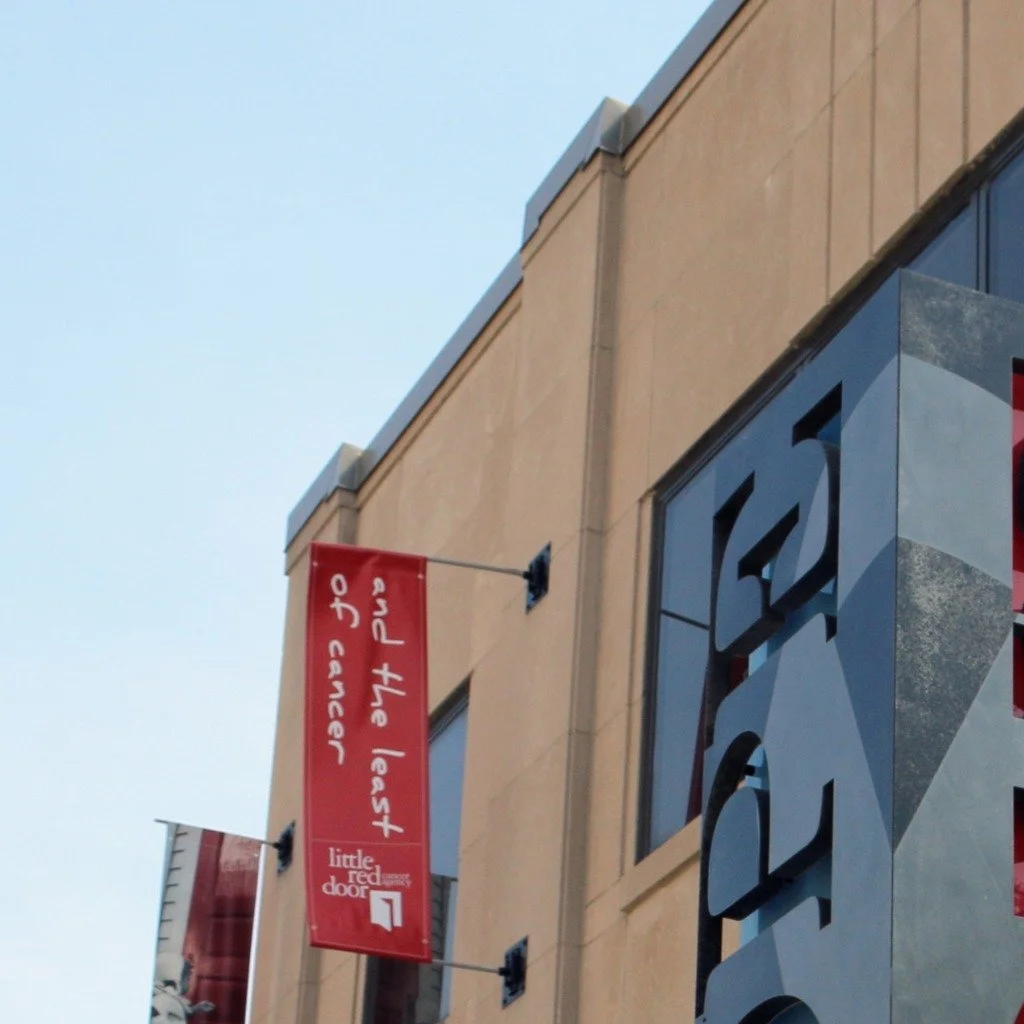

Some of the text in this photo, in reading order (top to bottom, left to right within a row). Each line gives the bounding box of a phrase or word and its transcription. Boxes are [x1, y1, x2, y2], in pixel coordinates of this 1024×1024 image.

[327, 573, 361, 765] of cancer
[371, 577, 407, 839] and the least
[328, 847, 375, 870] little
[321, 875, 370, 899] door
[347, 865, 381, 886] red
